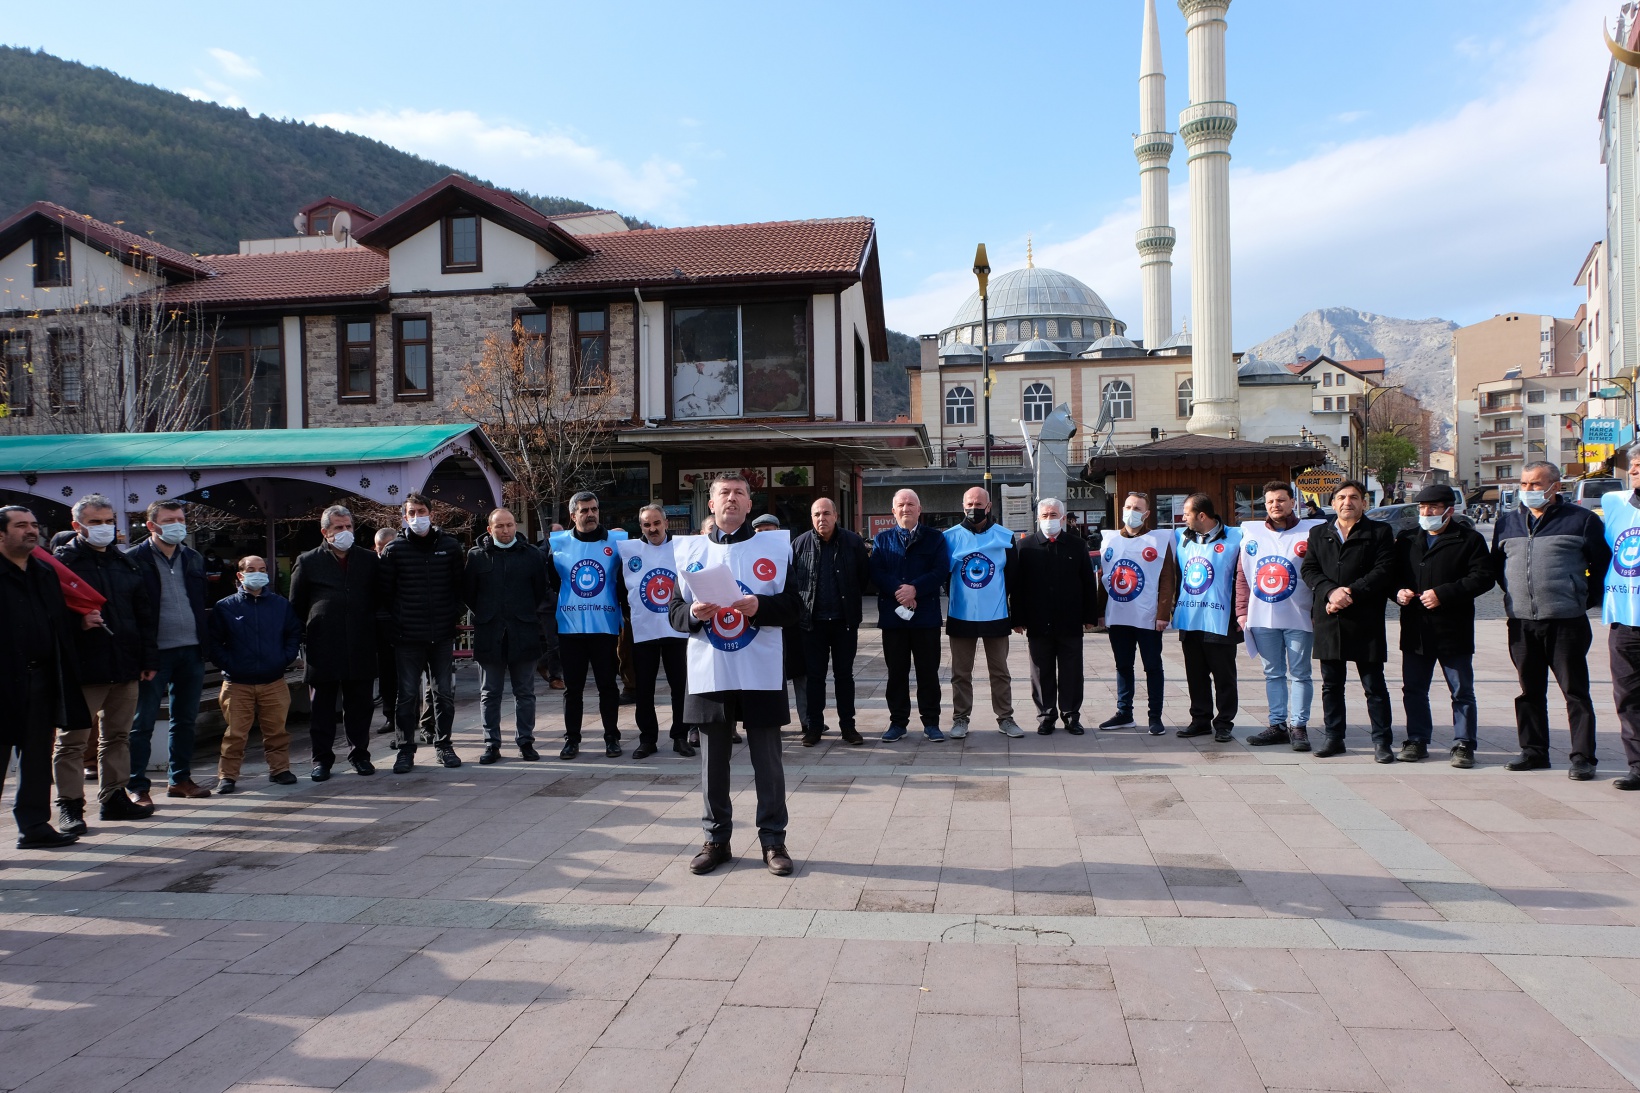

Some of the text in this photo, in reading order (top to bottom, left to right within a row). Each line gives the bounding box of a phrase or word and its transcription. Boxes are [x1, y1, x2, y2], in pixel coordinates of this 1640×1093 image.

[1067, 486, 1094, 500] RIK
[571, 566, 579, 582] TÜRK
[646, 569, 675, 580] SAĞLIK
[1606, 584, 1618, 594] RK
[560, 603, 616, 612] TÜRK EĞİTİM-SEN
[1186, 600, 1224, 610] EĞİTİM-SEN
[724, 642, 739, 650] 1992
